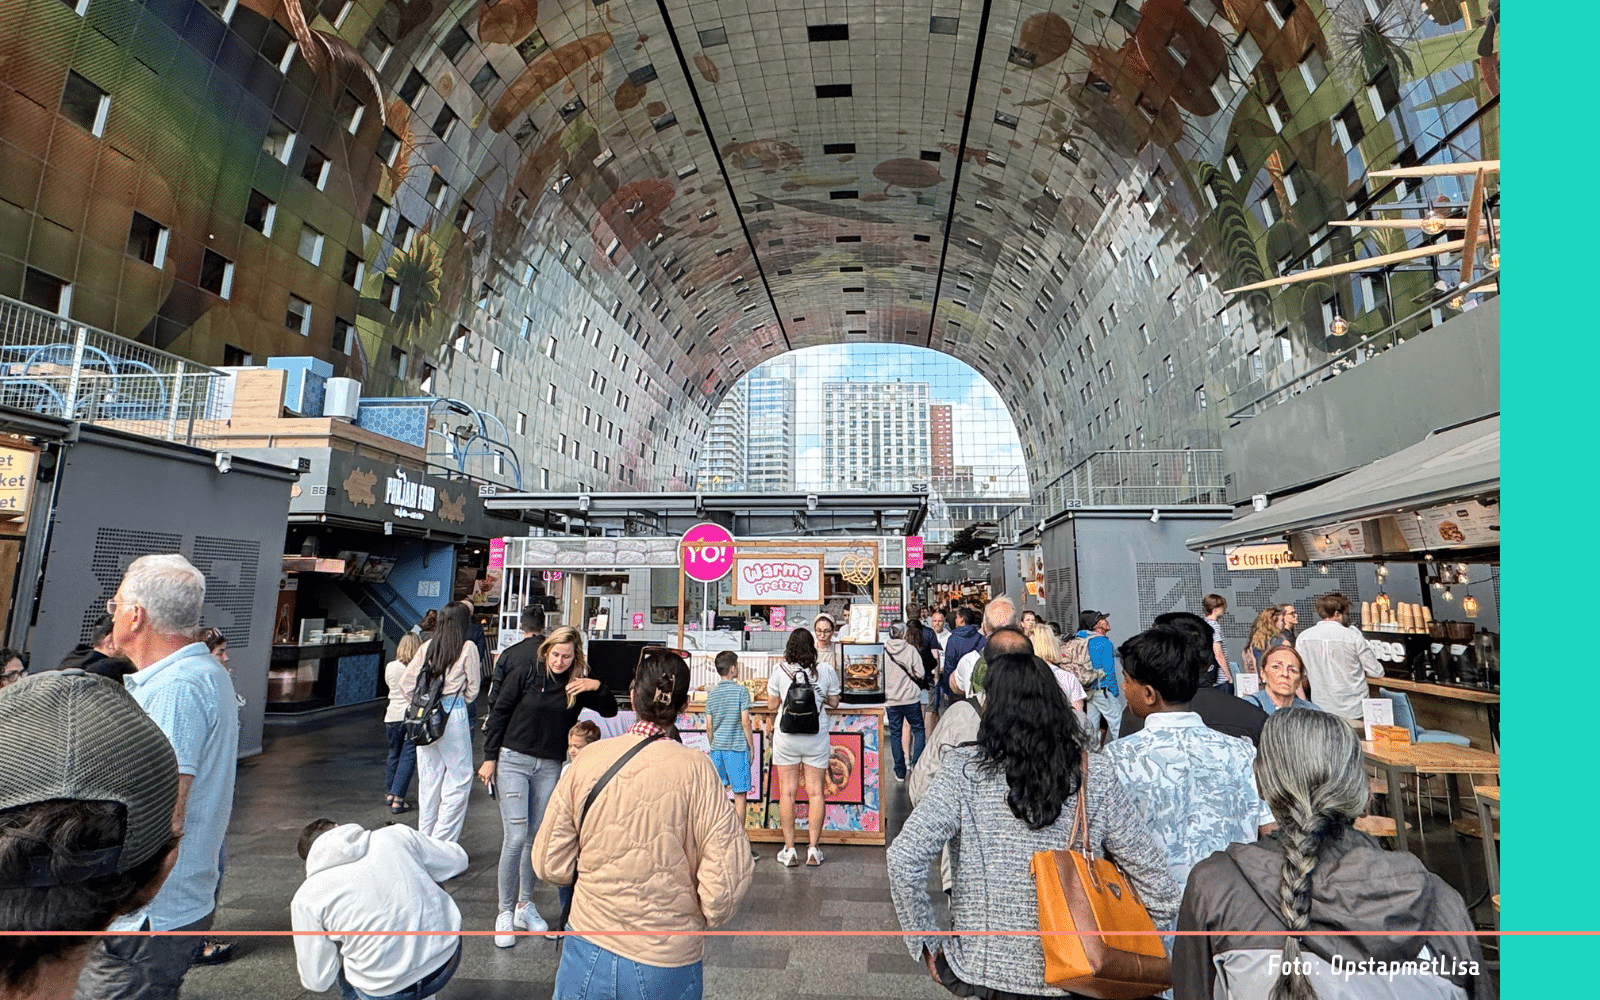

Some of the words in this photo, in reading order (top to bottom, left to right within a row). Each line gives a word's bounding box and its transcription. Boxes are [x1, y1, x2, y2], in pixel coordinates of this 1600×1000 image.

[312, 486, 326, 495] 86
[480, 486, 495, 495] 56
[912, 483, 928, 493] 52
[1067, 499, 1082, 508] 32
[743, 562, 812, 583] Warme
